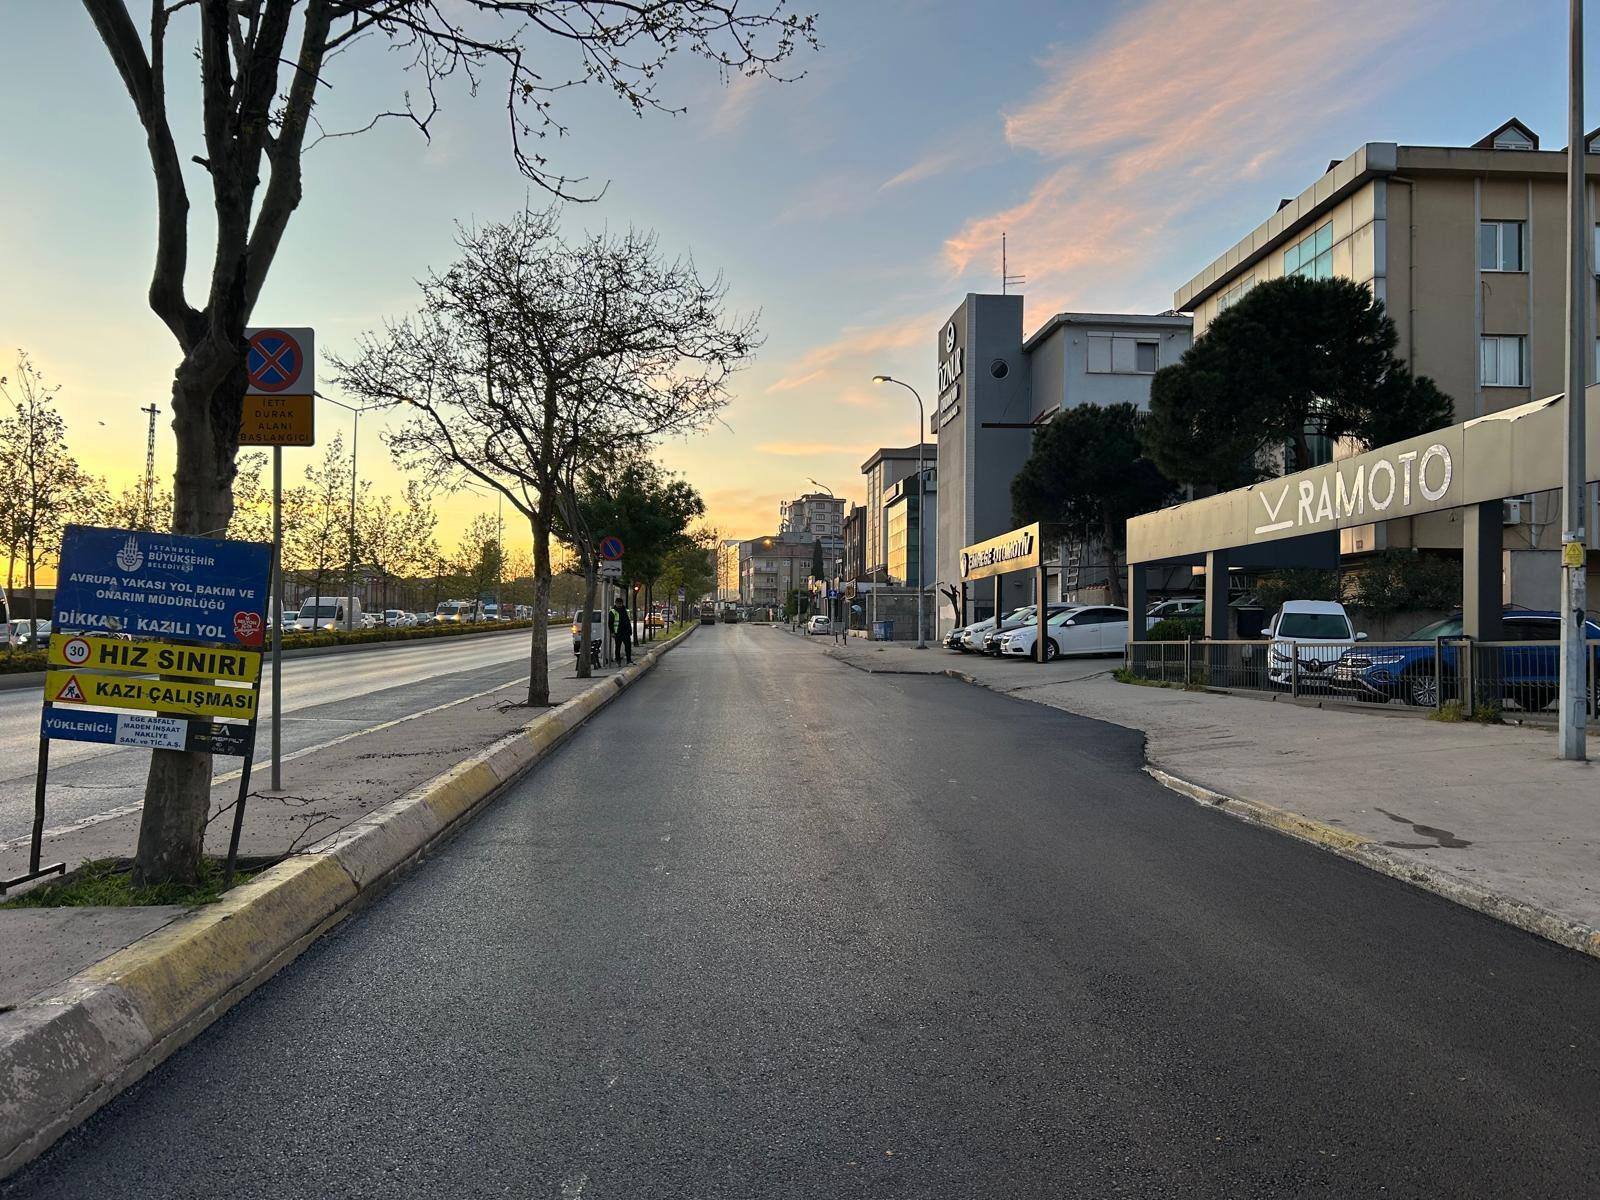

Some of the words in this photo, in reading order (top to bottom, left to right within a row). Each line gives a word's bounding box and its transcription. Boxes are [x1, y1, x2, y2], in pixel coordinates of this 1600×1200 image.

[255, 410, 294, 418] DURAK
[259, 422, 292, 430] ALANI
[1298, 443, 1453, 527] RAMOTO
[149, 544, 195, 554] İSTANBUL
[148, 552, 215, 566] BÜYÜKŞEHİR
[69, 572, 118, 586] AVRUPA
[122, 578, 166, 590] YAKASI
[169, 583, 193, 593] YOL
[196, 585, 235, 597] BAKIM
[239, 589, 255, 599] VE
[96, 590, 145, 603] ONARIM
[148, 593, 226, 611] MÜDÜRLÜĞÜ
[59, 609, 128, 630] DİKKA!
[137, 618, 190, 635] KAZILI
[195, 625, 227, 638] YOL
[69, 645, 85, 657] 30
[100, 644, 149, 668] HIZ
[157, 649, 246, 676] SINIRI
[96, 682, 142, 699] KAZI
[150, 687, 252, 709] ÇALIŞMASI
[46, 719, 113, 734] YÜKLENİCİ:
[134, 731, 168, 739] NAKLİYE
